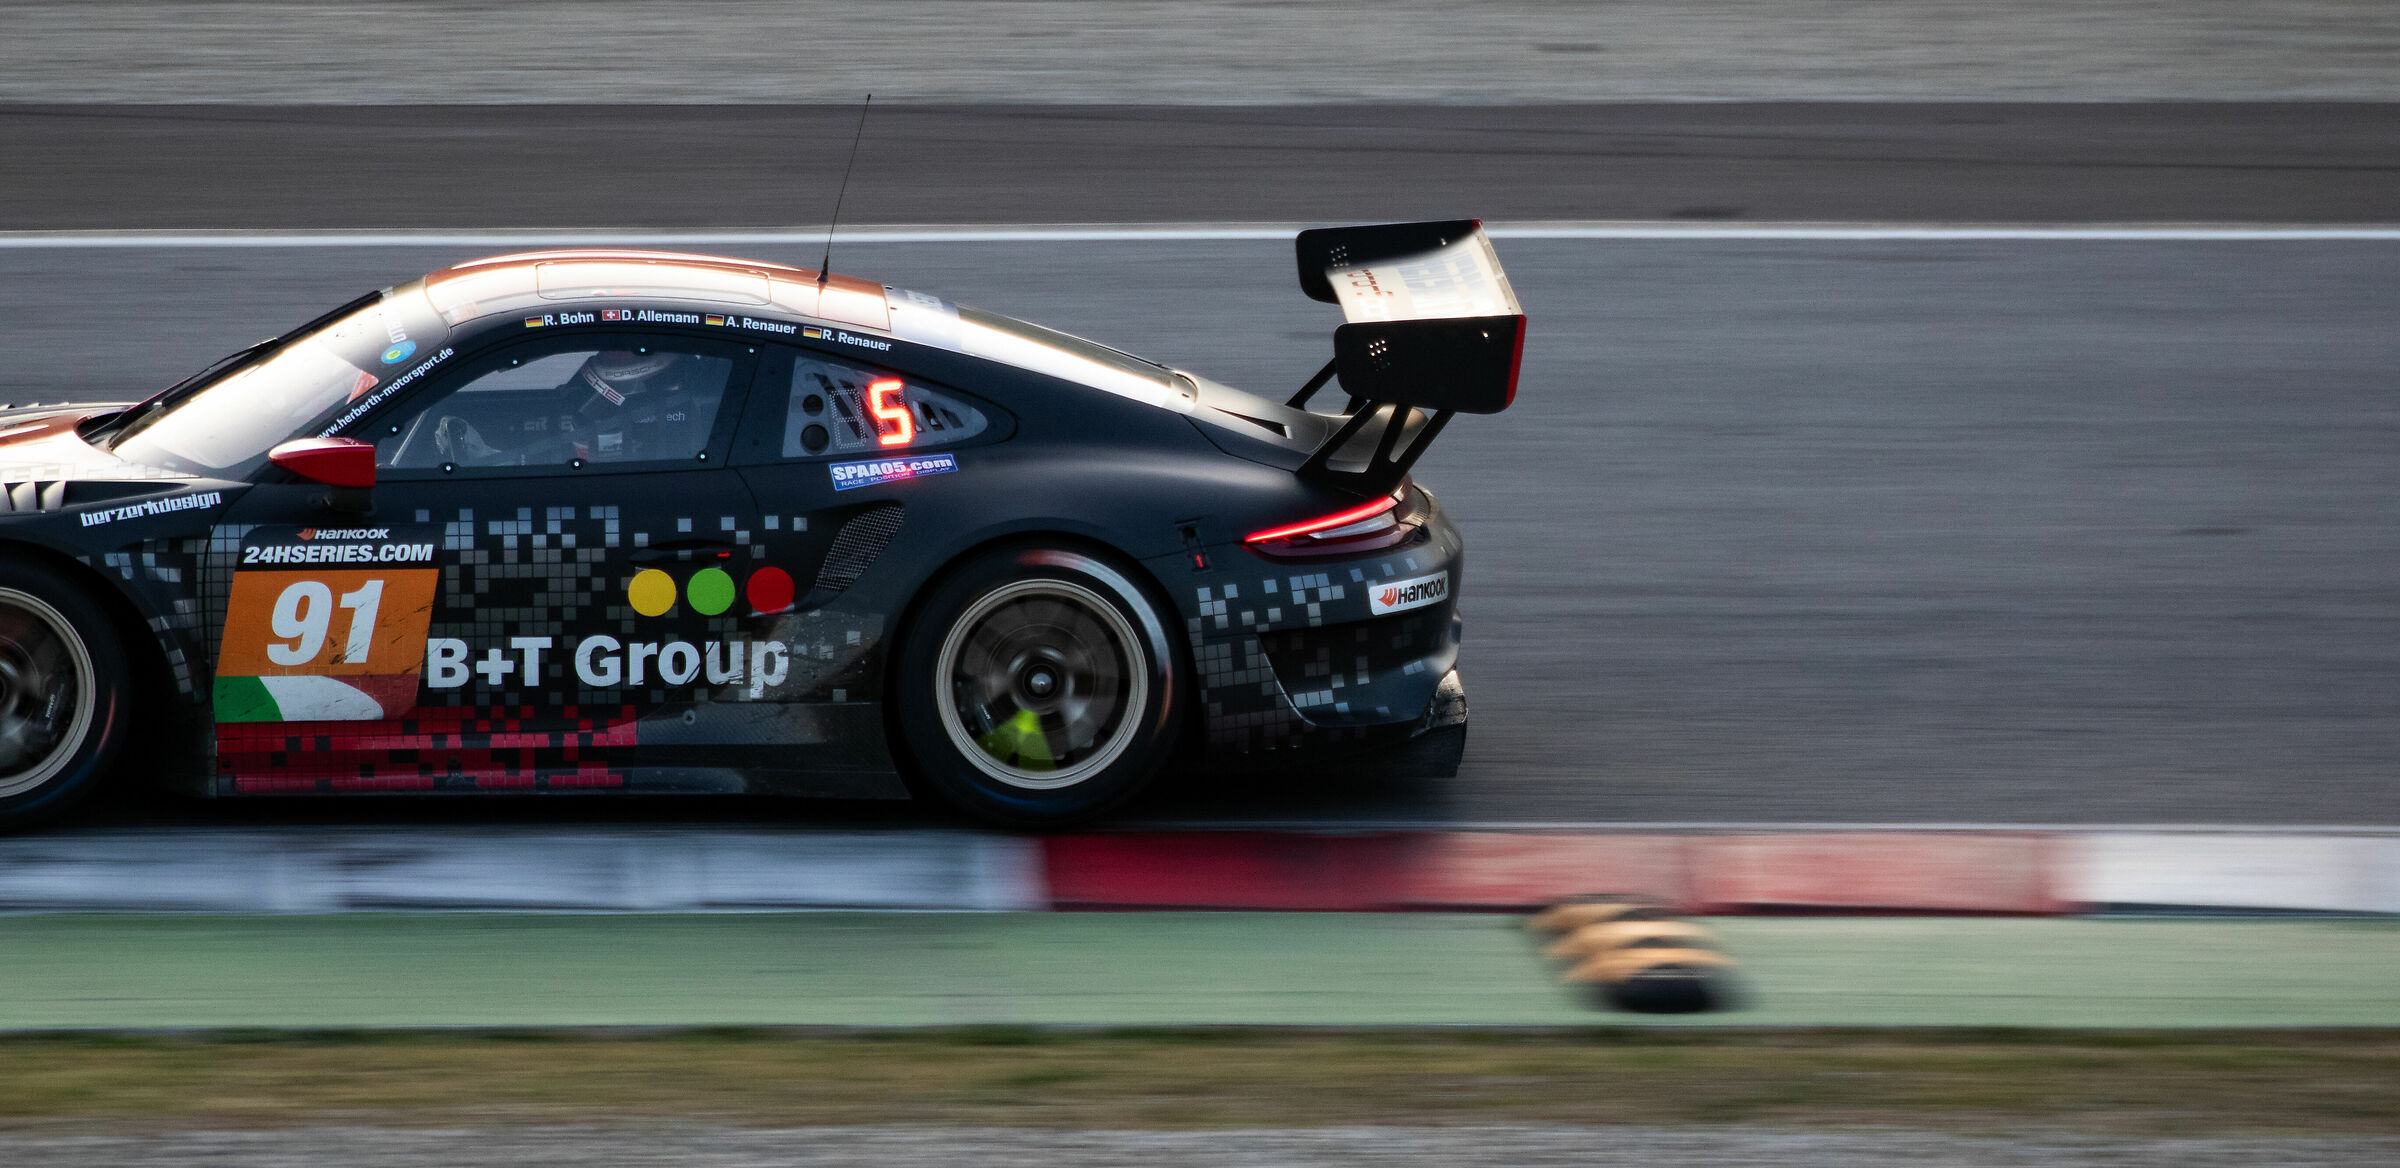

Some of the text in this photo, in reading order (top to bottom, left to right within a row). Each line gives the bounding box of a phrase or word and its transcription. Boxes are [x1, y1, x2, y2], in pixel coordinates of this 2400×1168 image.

[544, 311, 595, 326] R. Bohn
[621, 309, 699, 324] D. Allemann
[726, 316, 797, 334] A. Renauer
[822, 328, 892, 352] R. Renauer
[316, 347, 454, 439] ww.herberth-motorsport.de
[868, 379, 915, 446] 5
[841, 479, 865, 487] RACE
[870, 472, 911, 482] POSITION
[80, 491, 222, 527] berzerkdesign
[243, 544, 434, 564] 24HSERIES.COM
[267, 580, 385, 666] 91
[427, 634, 790, 699] B+T Group
